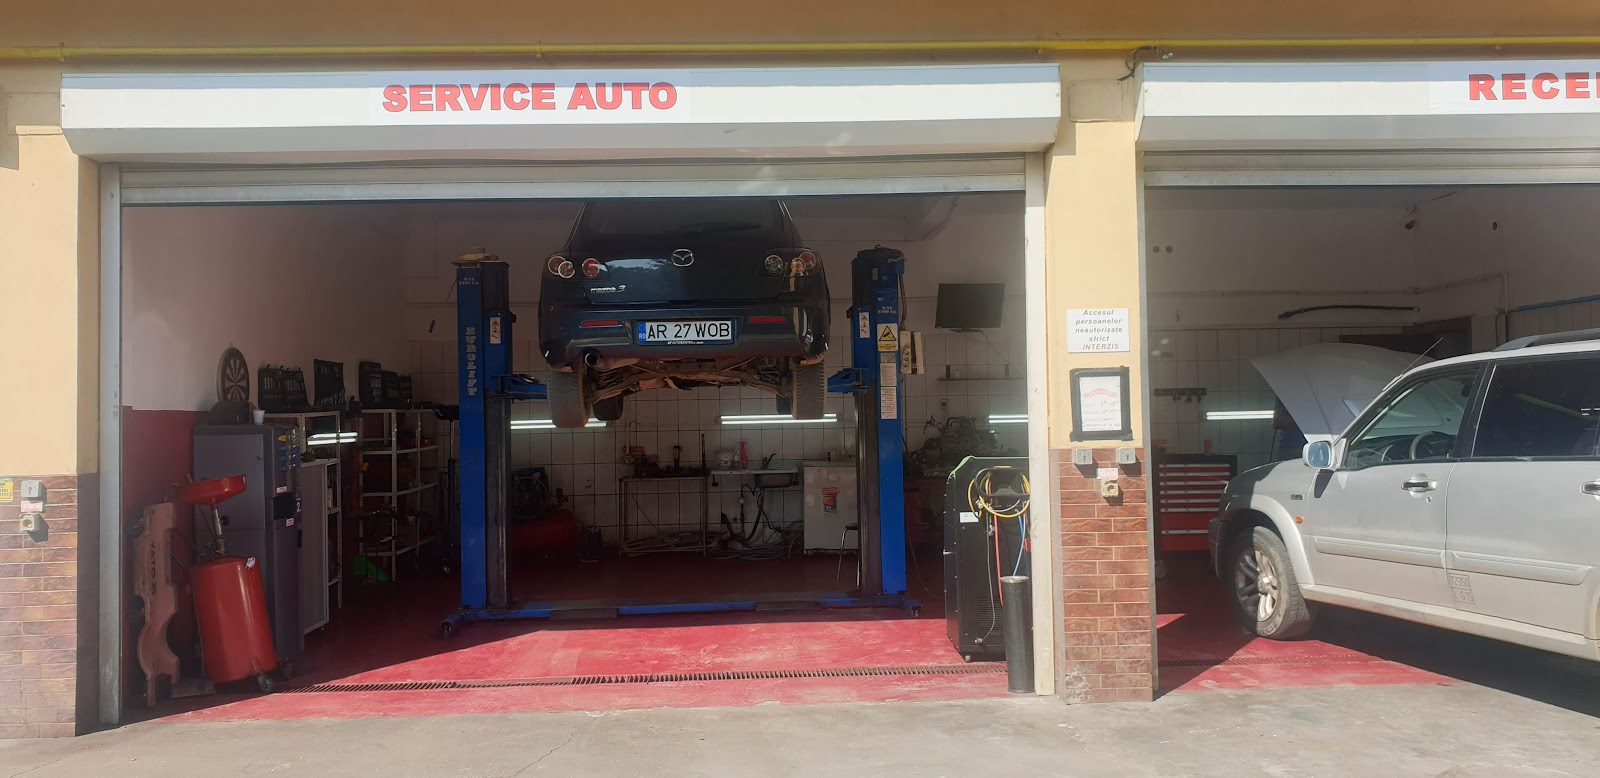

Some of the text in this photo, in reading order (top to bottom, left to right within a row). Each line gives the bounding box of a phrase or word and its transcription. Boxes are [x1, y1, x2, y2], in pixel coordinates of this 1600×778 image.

[1468, 72, 1600, 100] RECE
[382, 82, 677, 112] SERVICE AUTO
[616, 285, 627, 293] 3
[1075, 318, 1122, 326] persoanelor
[1075, 326, 1123, 334] neautorizate
[647, 324, 667, 339] AR
[673, 323, 692, 338] 27
[694, 323, 730, 338] WOB
[465, 326, 477, 396] EUROLIFT
